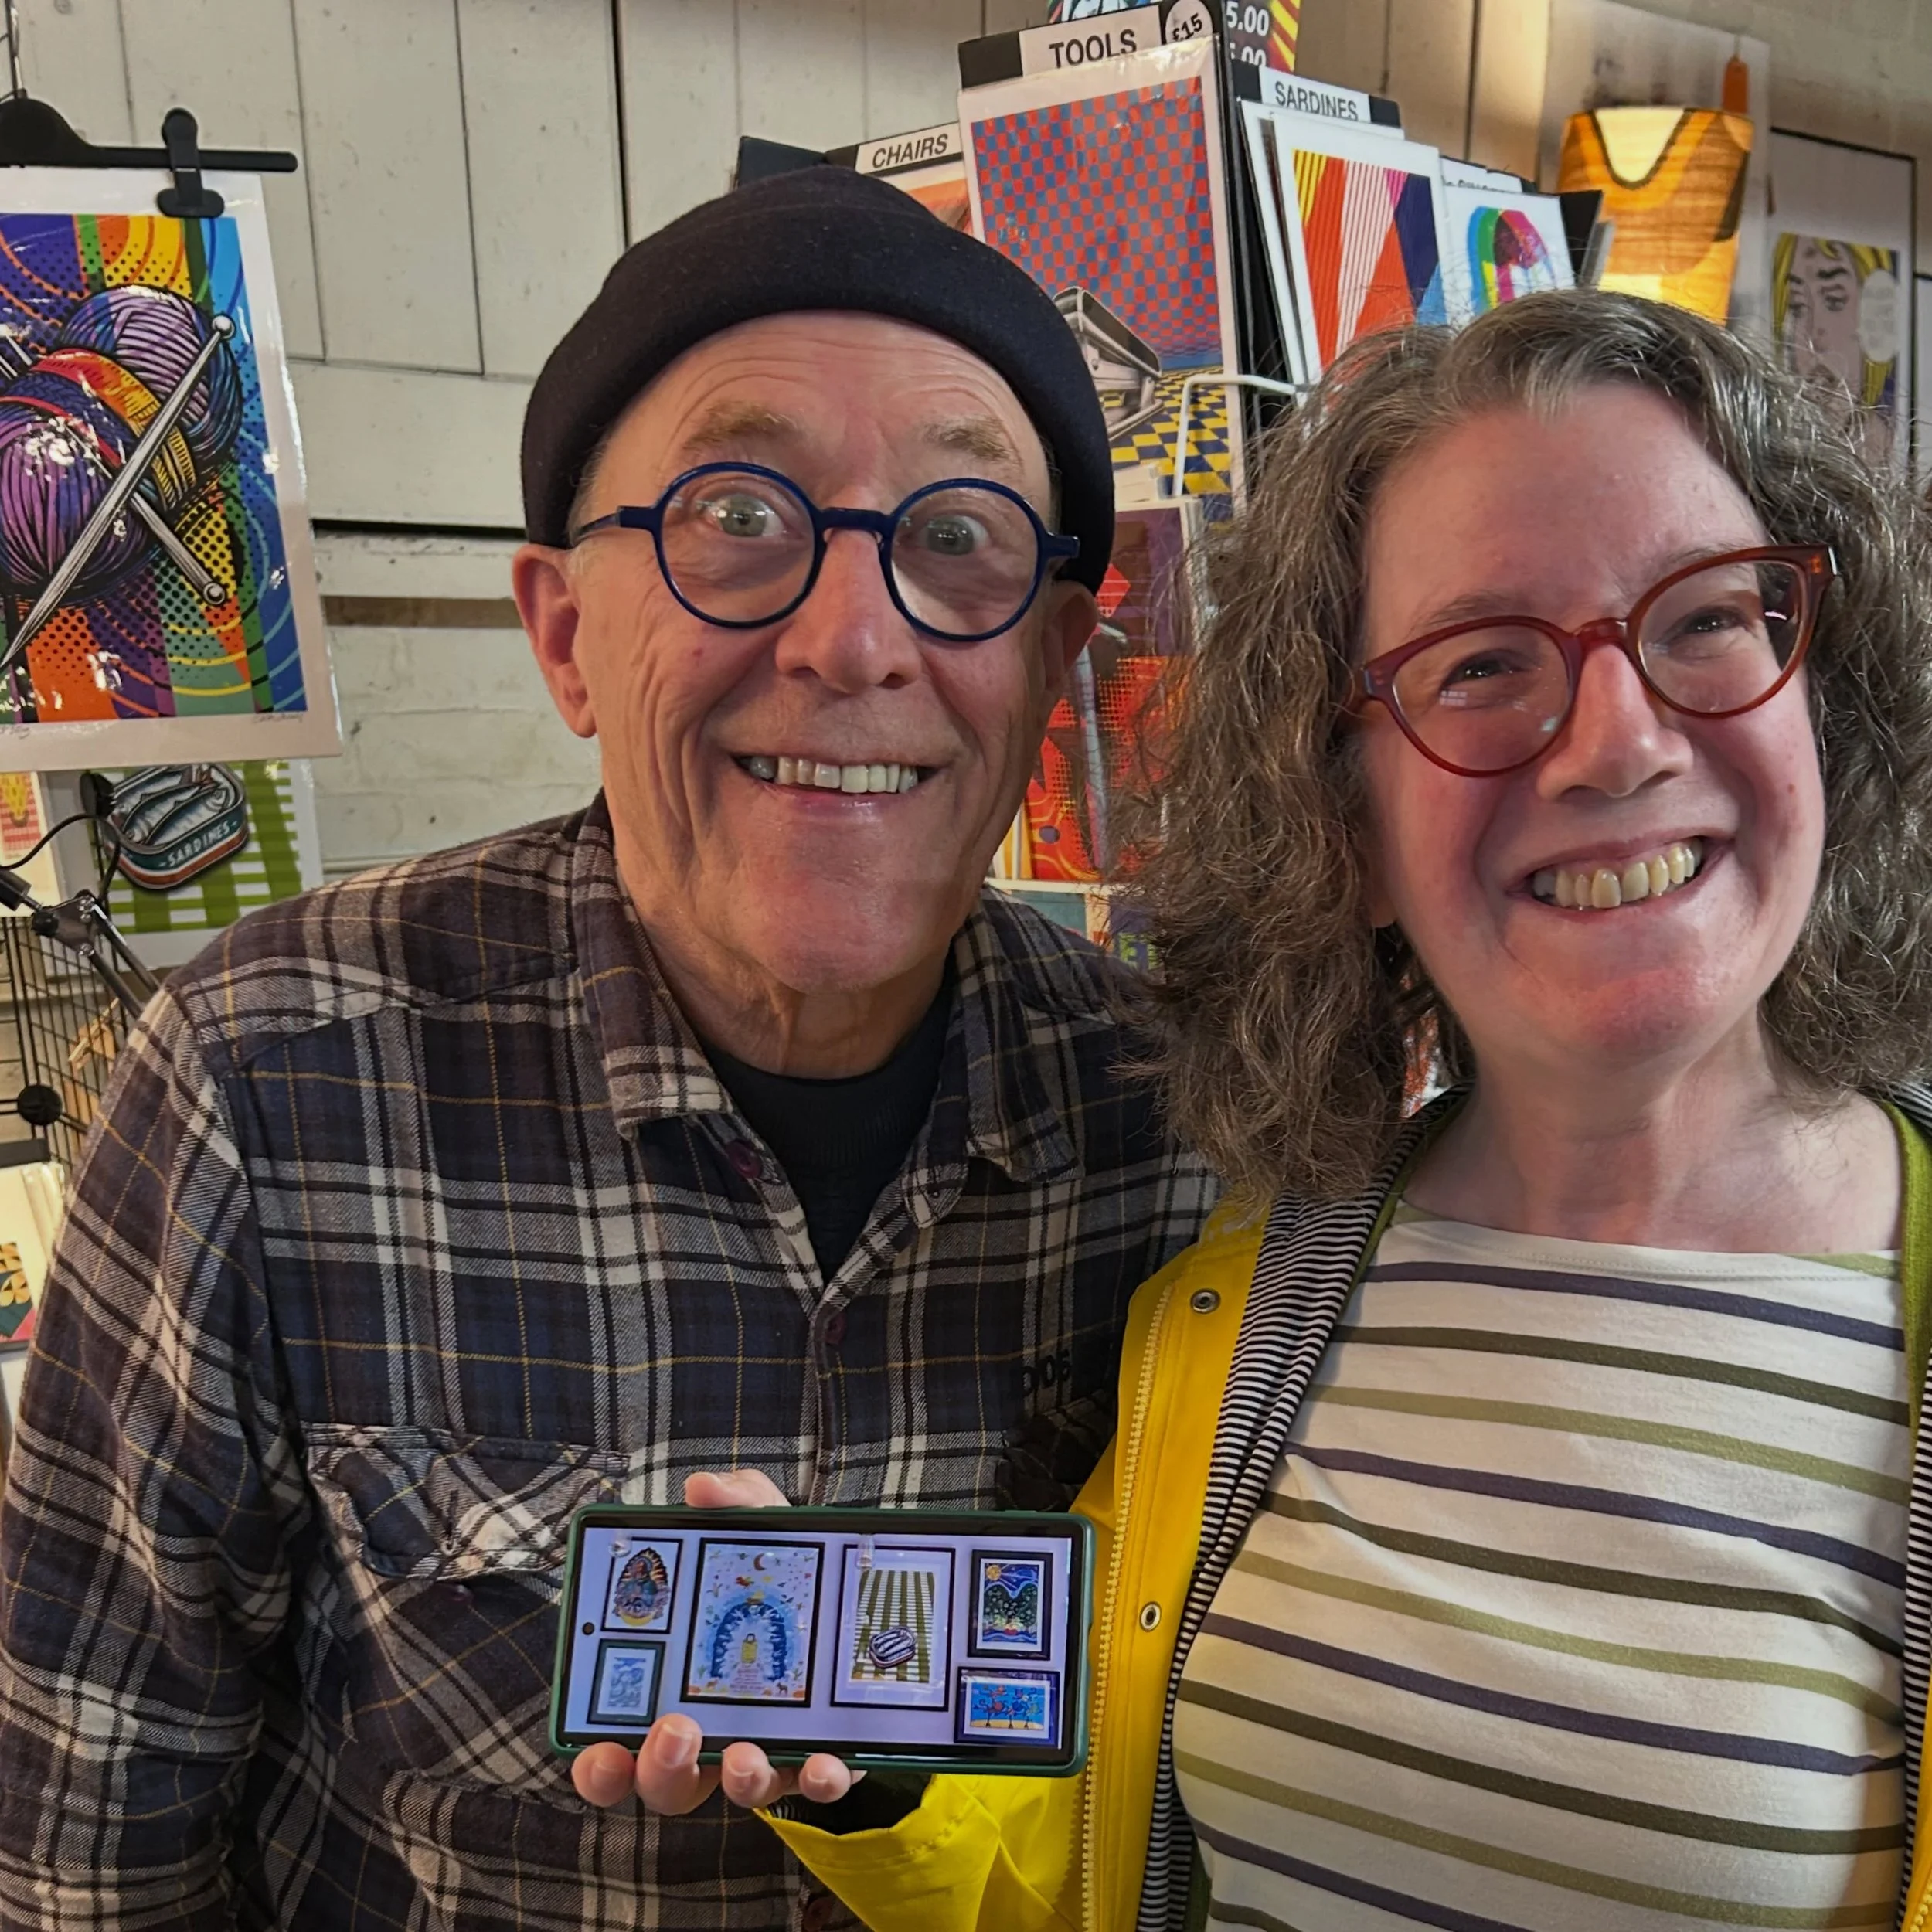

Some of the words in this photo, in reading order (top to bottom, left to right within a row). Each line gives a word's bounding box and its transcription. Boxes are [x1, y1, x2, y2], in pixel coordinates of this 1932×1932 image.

[1171, 12, 1202, 41] £15
[1049, 29, 1137, 69] TOOLS
[1274, 80, 1359, 121] SARDINES
[872, 133, 948, 168] CHAIRS
